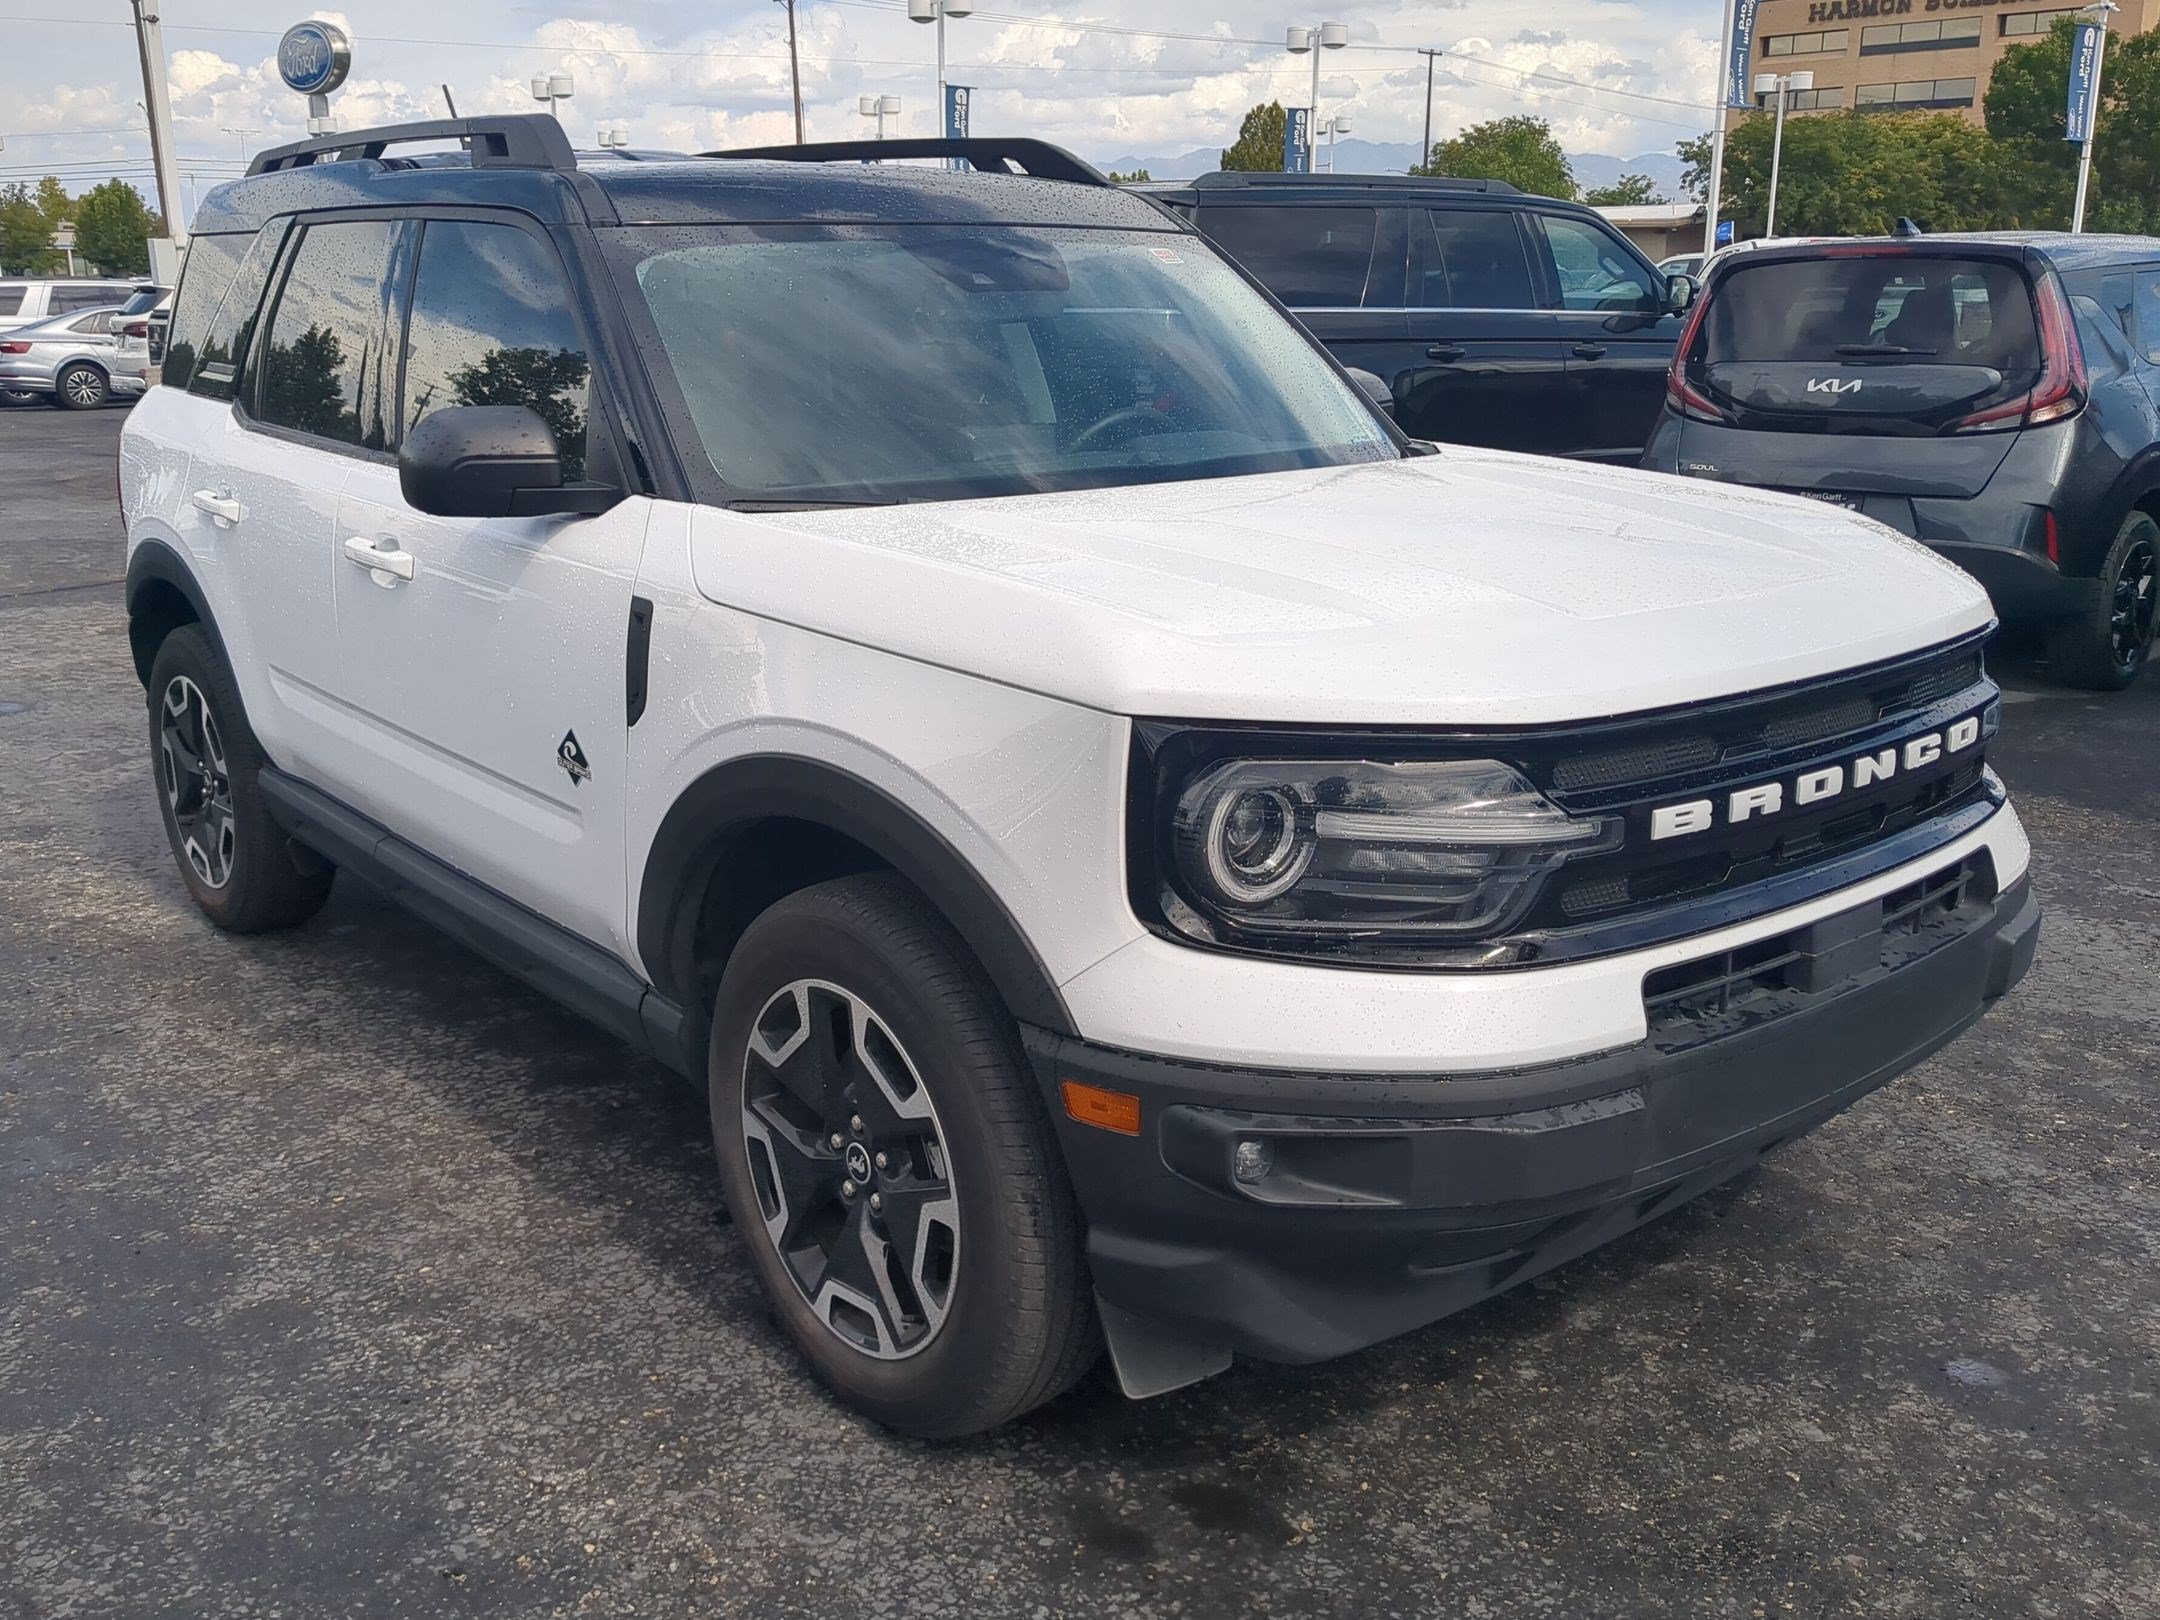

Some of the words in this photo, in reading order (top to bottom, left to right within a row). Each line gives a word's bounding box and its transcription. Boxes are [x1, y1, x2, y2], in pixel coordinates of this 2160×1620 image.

[1808, 0, 1912, 22] HARMON
[1744, 18, 1752, 44] Garff
[286, 38, 320, 78] Ford
[2079, 48, 2087, 76] Ford
[1807, 378, 1862, 393] KIA
[1689, 463, 1719, 472] SOUL
[1806, 491, 1821, 500] Ken
[1821, 492, 1842, 501] Garff
[1651, 717, 1978, 841] BRONCO
